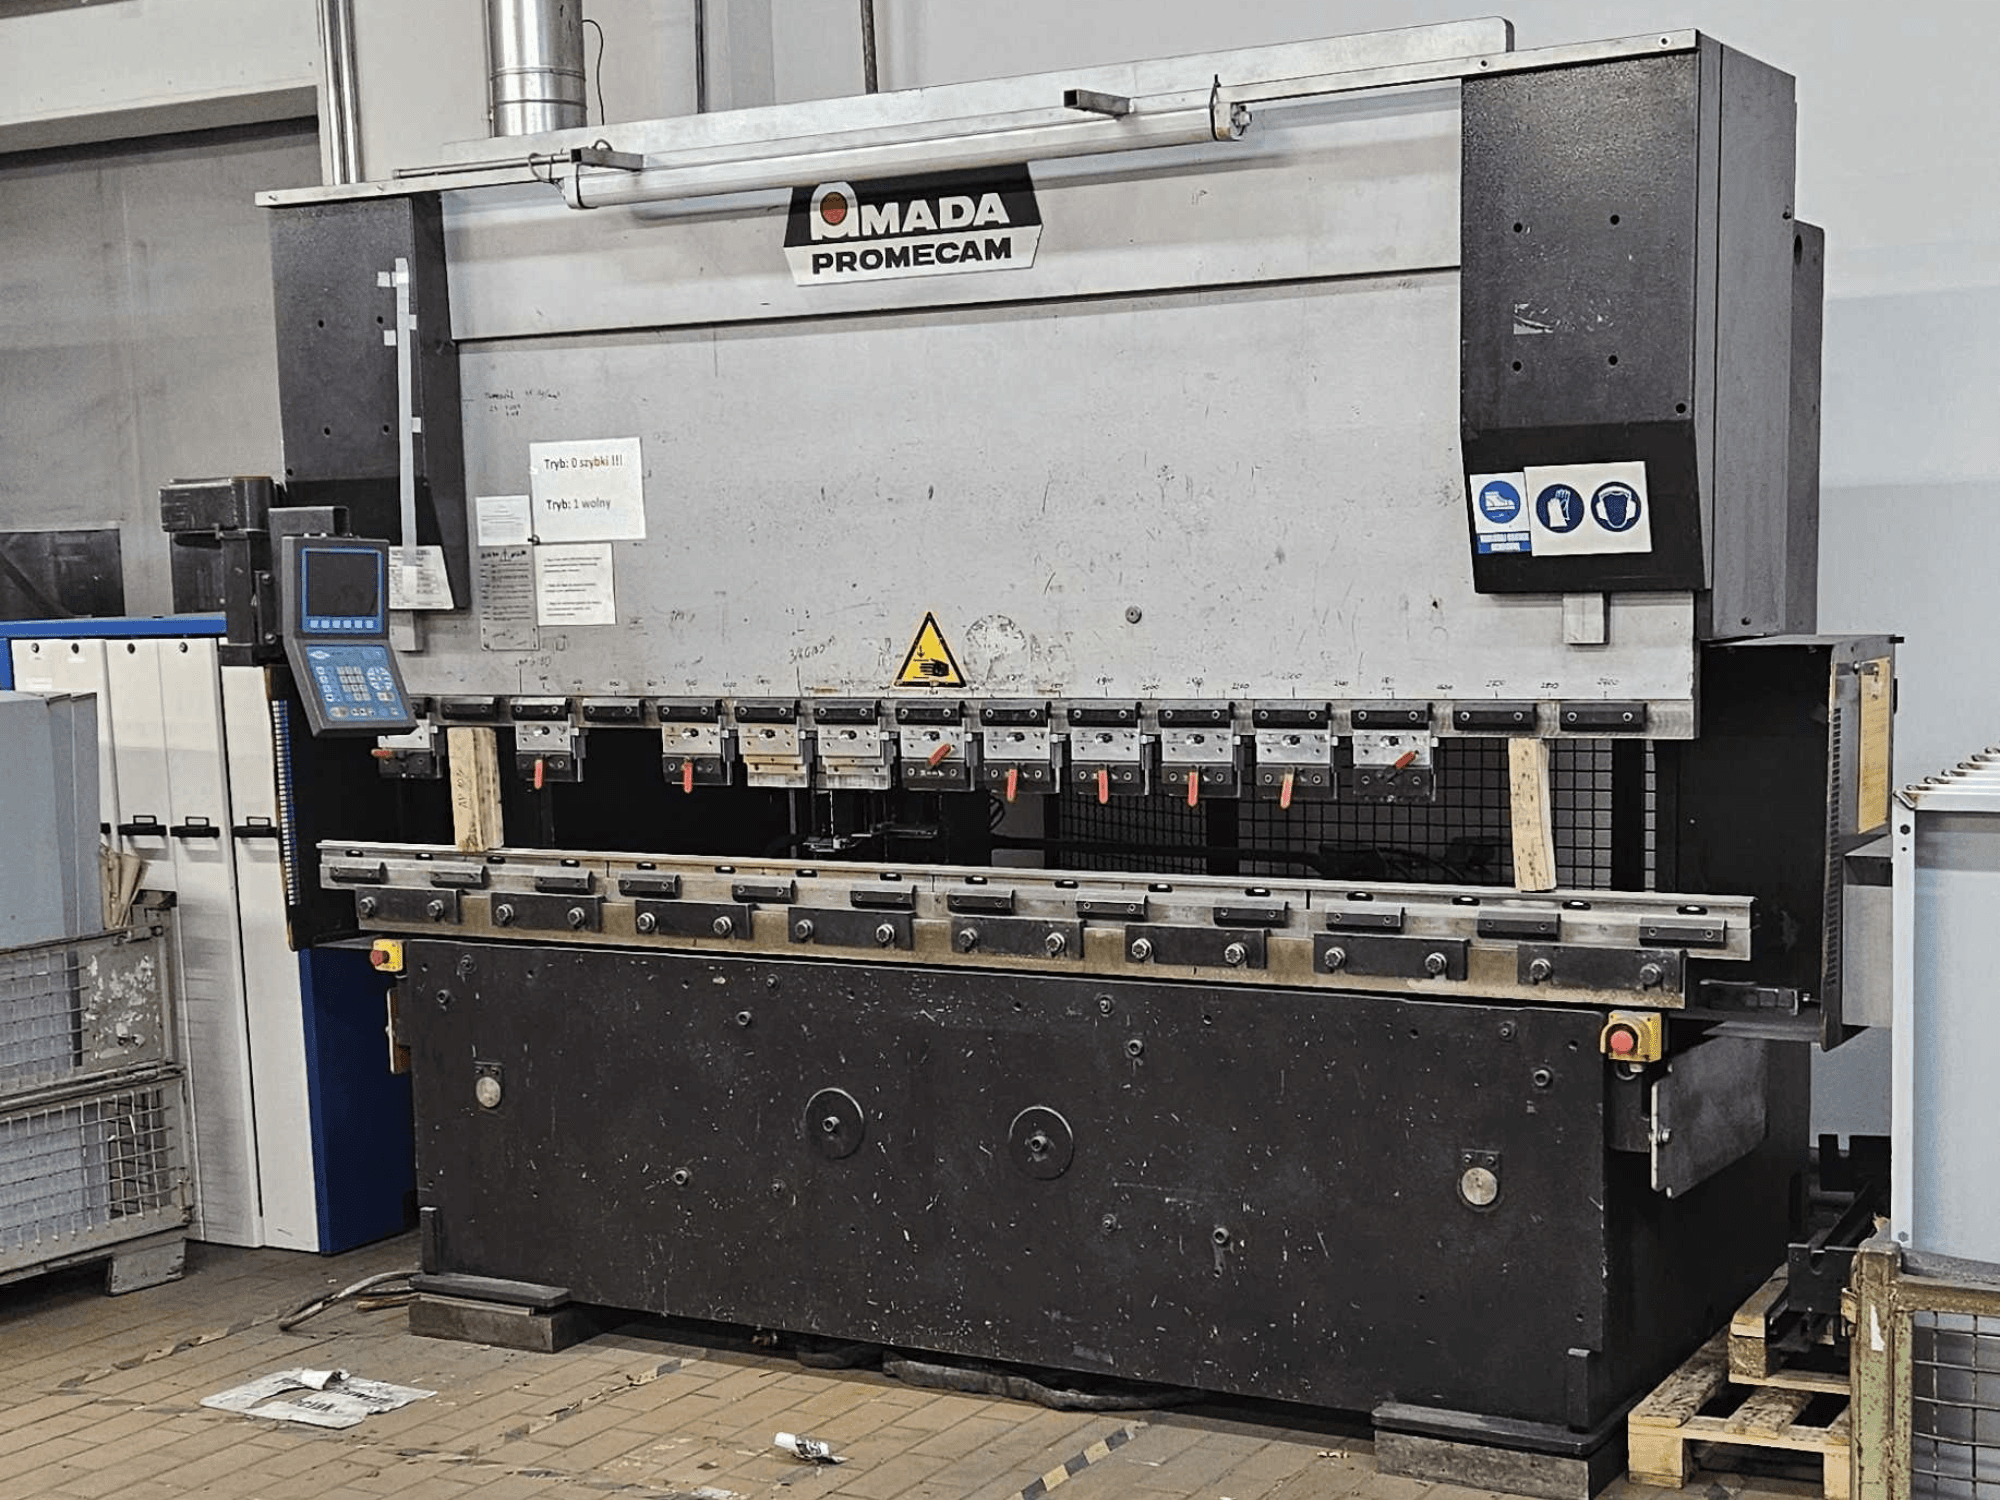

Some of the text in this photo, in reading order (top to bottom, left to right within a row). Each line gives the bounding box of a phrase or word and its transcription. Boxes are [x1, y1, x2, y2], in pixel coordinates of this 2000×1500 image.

[810, 182, 1010, 240] AMADA
[811, 238, 1012, 274] PROMECAM
[543, 458, 569, 471] Tryb:
[571, 457, 578, 469] 0
[579, 455, 609, 470] szybki
[546, 499, 571, 512] Tryb:
[581, 497, 611, 511] wolny
